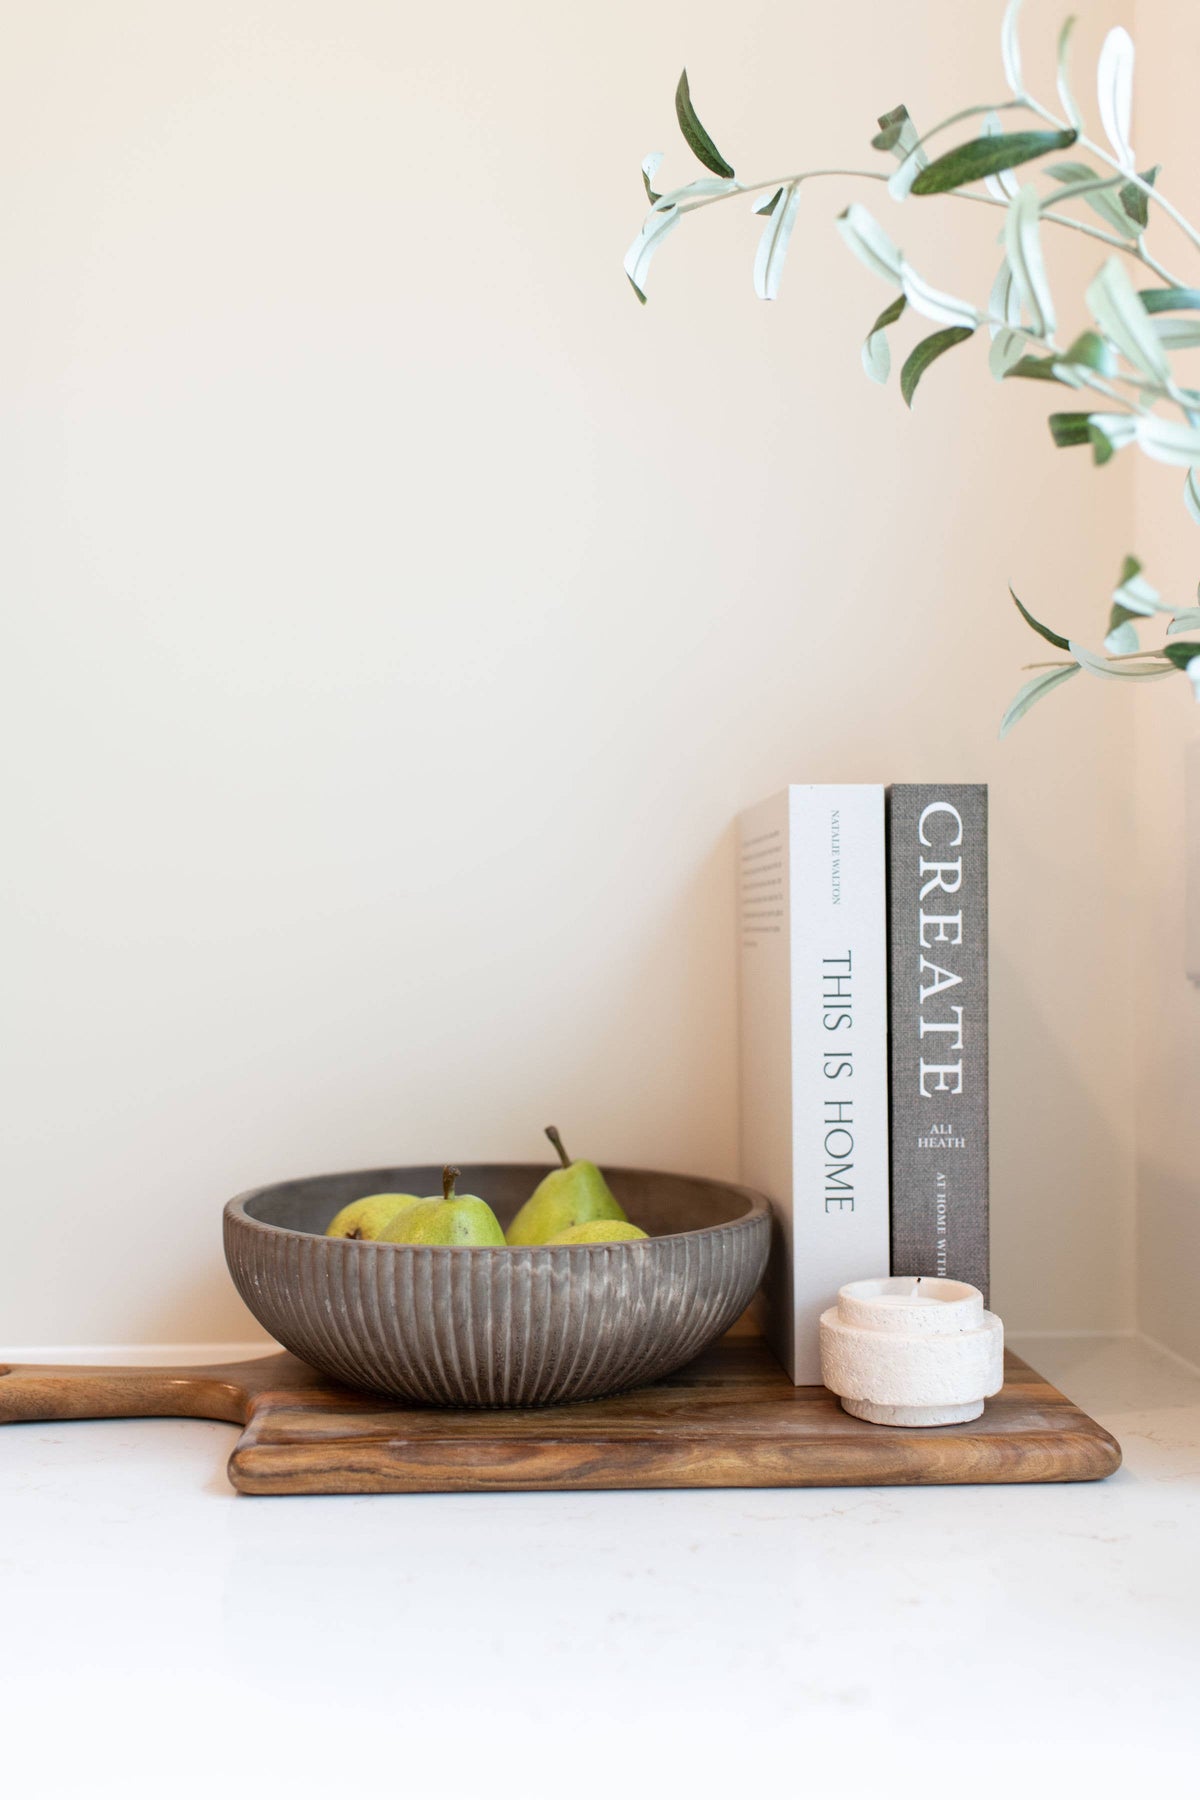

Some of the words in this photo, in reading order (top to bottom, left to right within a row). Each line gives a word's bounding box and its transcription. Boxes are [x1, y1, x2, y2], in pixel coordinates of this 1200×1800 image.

[831, 809, 840, 856] NATALIE
[832, 858, 841, 905] WALTON
[918, 801, 964, 1098] CREATE
[822, 949, 853, 1032] THIS
[823, 1052, 853, 1080] IS
[918, 1137, 966, 1149] HEATH
[929, 1124, 952, 1135] ALI
[823, 1100, 855, 1214] HOME
[936, 1172, 946, 1189] AT
[936, 1193, 947, 1234] HOME
[937, 1238, 947, 1277] WITH
